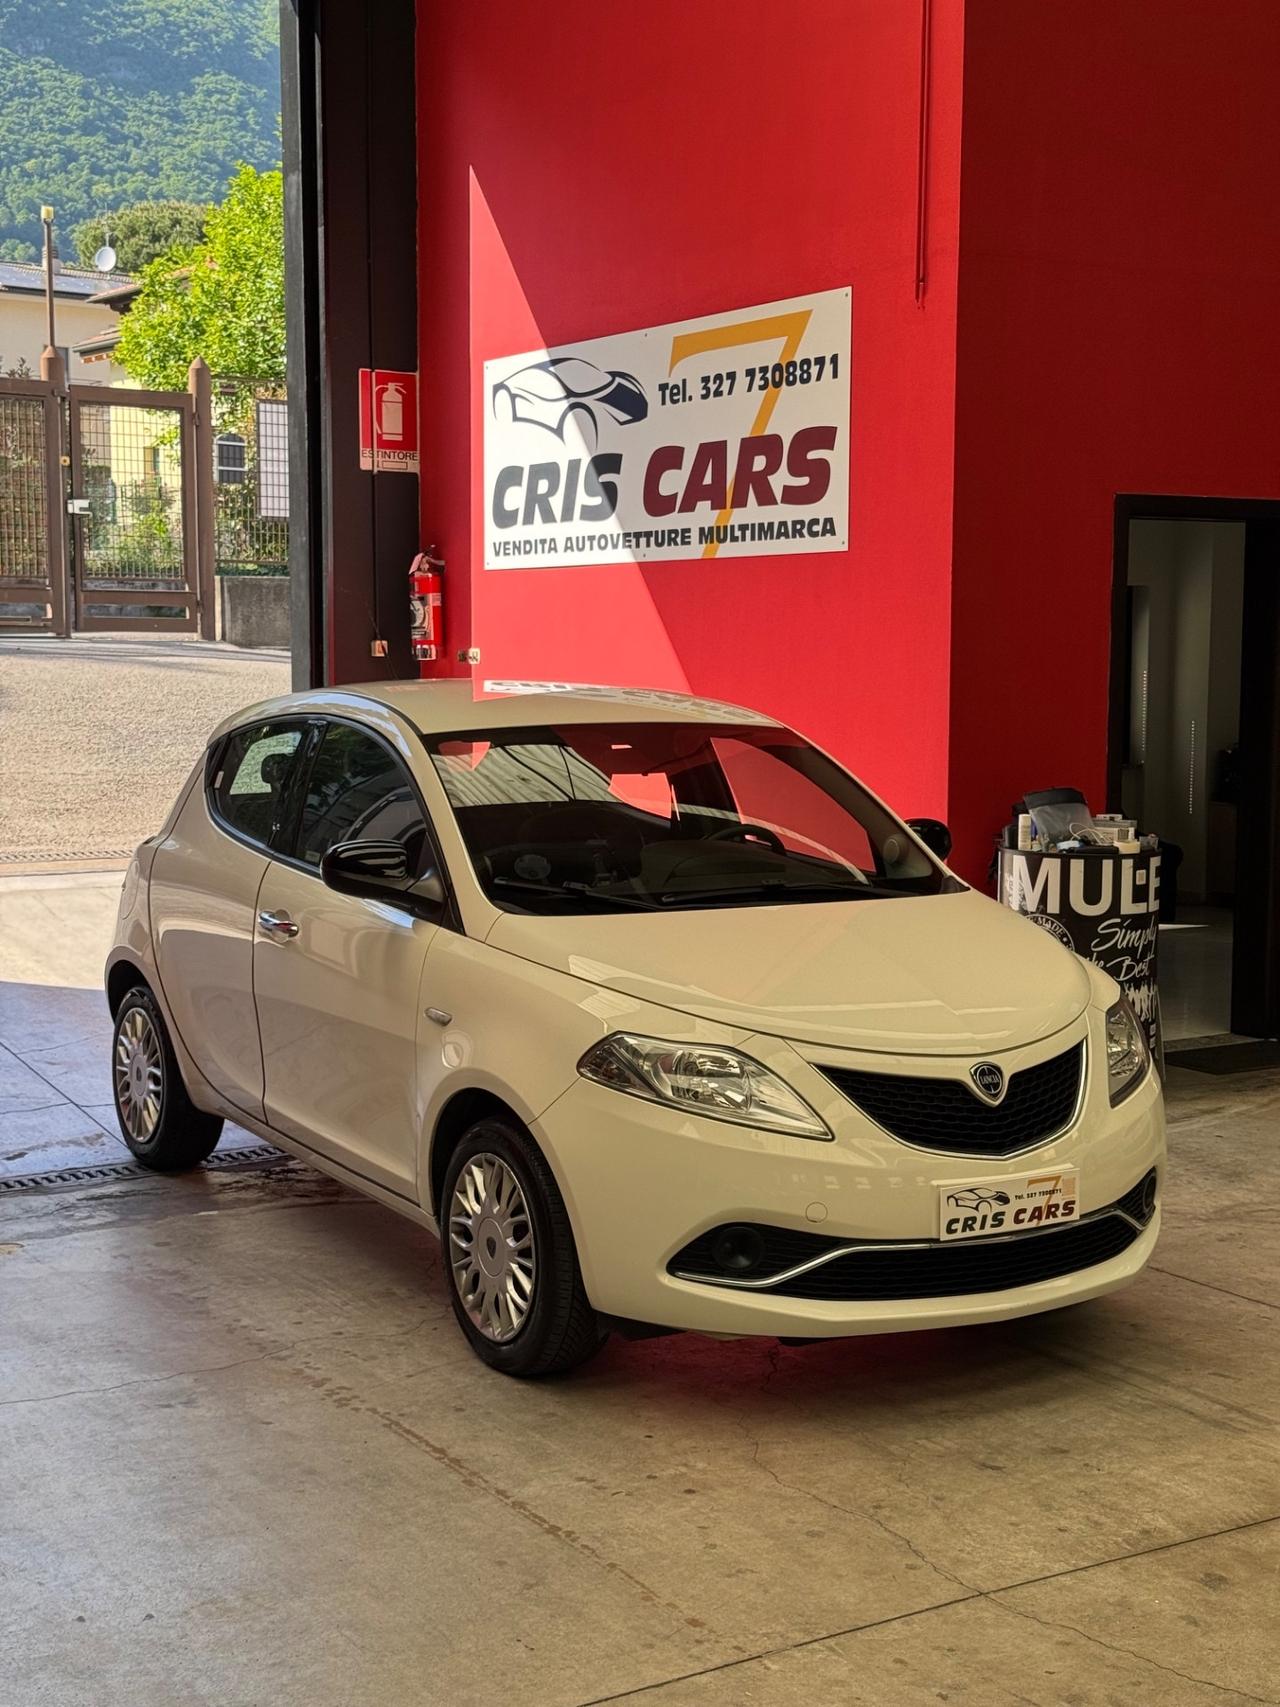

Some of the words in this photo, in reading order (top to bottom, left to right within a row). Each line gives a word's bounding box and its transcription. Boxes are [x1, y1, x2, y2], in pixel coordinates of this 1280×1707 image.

[658, 379, 693, 406] Tel.
[700, 371, 737, 401] 327
[745, 353, 839, 393] 7308871
[361, 449, 418, 461] ESTINTORE
[492, 453, 623, 529] CRIS
[643, 426, 838, 517] CARS
[493, 537, 558, 557] VENDITA
[563, 528, 692, 553] AUTOVETTURE
[698, 517, 837, 545] MULTIMARCA
[1106, 952, 1155, 981] Best
[946, 1211, 1006, 1234] CRIS
[1013, 1200, 1076, 1225] CARS
